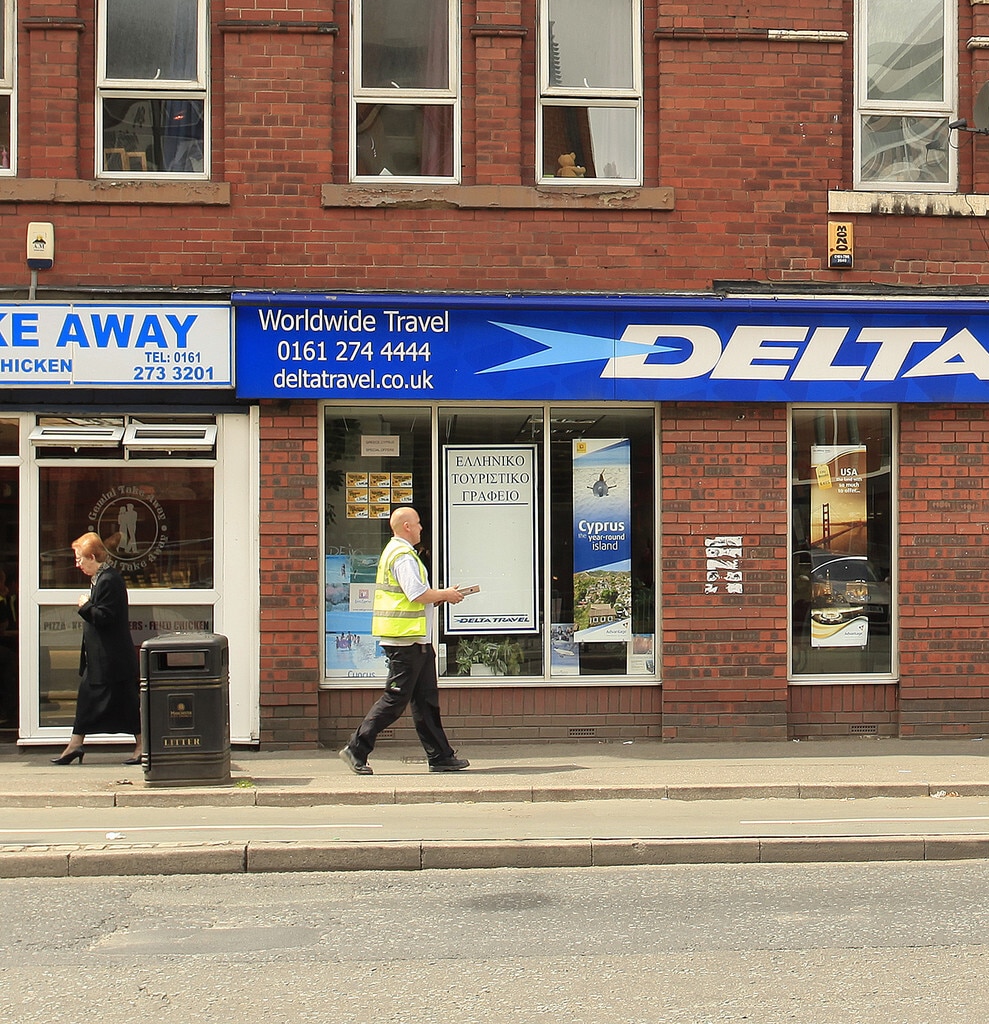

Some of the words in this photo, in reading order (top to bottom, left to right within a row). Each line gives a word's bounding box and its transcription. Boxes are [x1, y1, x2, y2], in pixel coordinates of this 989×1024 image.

[836, 225, 848, 251] MONO
[258, 309, 376, 332] Worldwide
[384, 310, 449, 333] Travel
[56, 314, 198, 348] AWAY
[145, 351, 170, 363] TEL:
[174, 352, 200, 363] 0161
[277, 341, 327, 361] 0161
[335, 341, 373, 361] 274
[380, 342, 431, 362] 4444
[133, 366, 166, 380] 273
[172, 366, 214, 380] 3201
[273, 368, 434, 389] deltatravel.co.uk
[456, 455, 525, 467] ΕΛΛΗΝΙΚΟ
[840, 468, 858, 476] USA
[451, 473, 530, 484] ΤΟΥΡΙΣΤΙΚΟ
[462, 490, 520, 501] ΓΡΑΦΕΙΟ
[117, 485, 145, 496] Take
[146, 494, 167, 521] Away
[578, 519, 625, 534] Cyprus
[588, 533, 625, 542] year-round
[592, 540, 618, 551] island
[119, 560, 148, 571] Take
[44, 621, 66, 631] PIZZA
[173, 621, 209, 631] CHICKEN
[164, 738, 200, 746] LITTER
